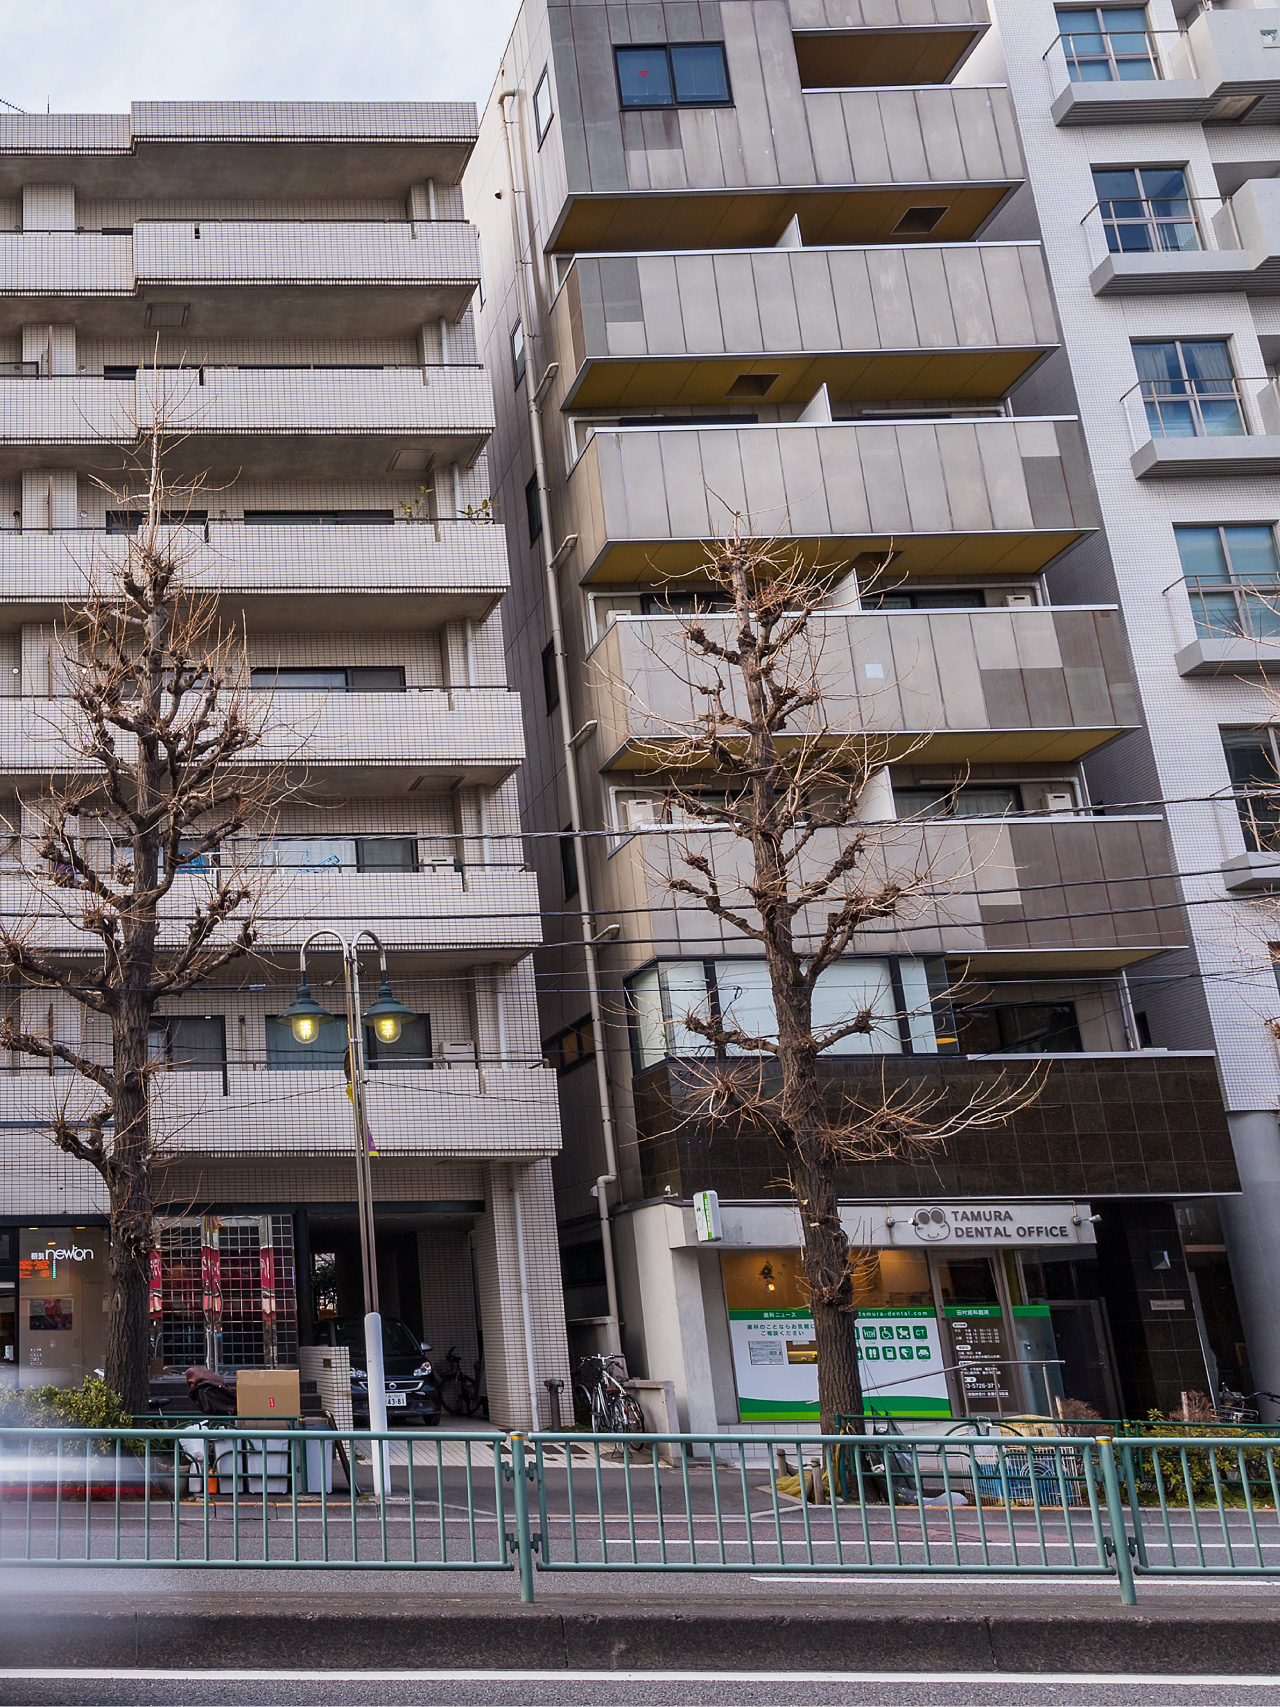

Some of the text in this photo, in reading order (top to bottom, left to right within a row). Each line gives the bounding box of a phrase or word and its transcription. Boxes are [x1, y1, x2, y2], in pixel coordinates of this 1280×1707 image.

[951, 1210, 1013, 1222] TAMURA
[954, 1225, 1069, 1238] DENTAL OFFICE
[45, 1244, 94, 1261] newton
